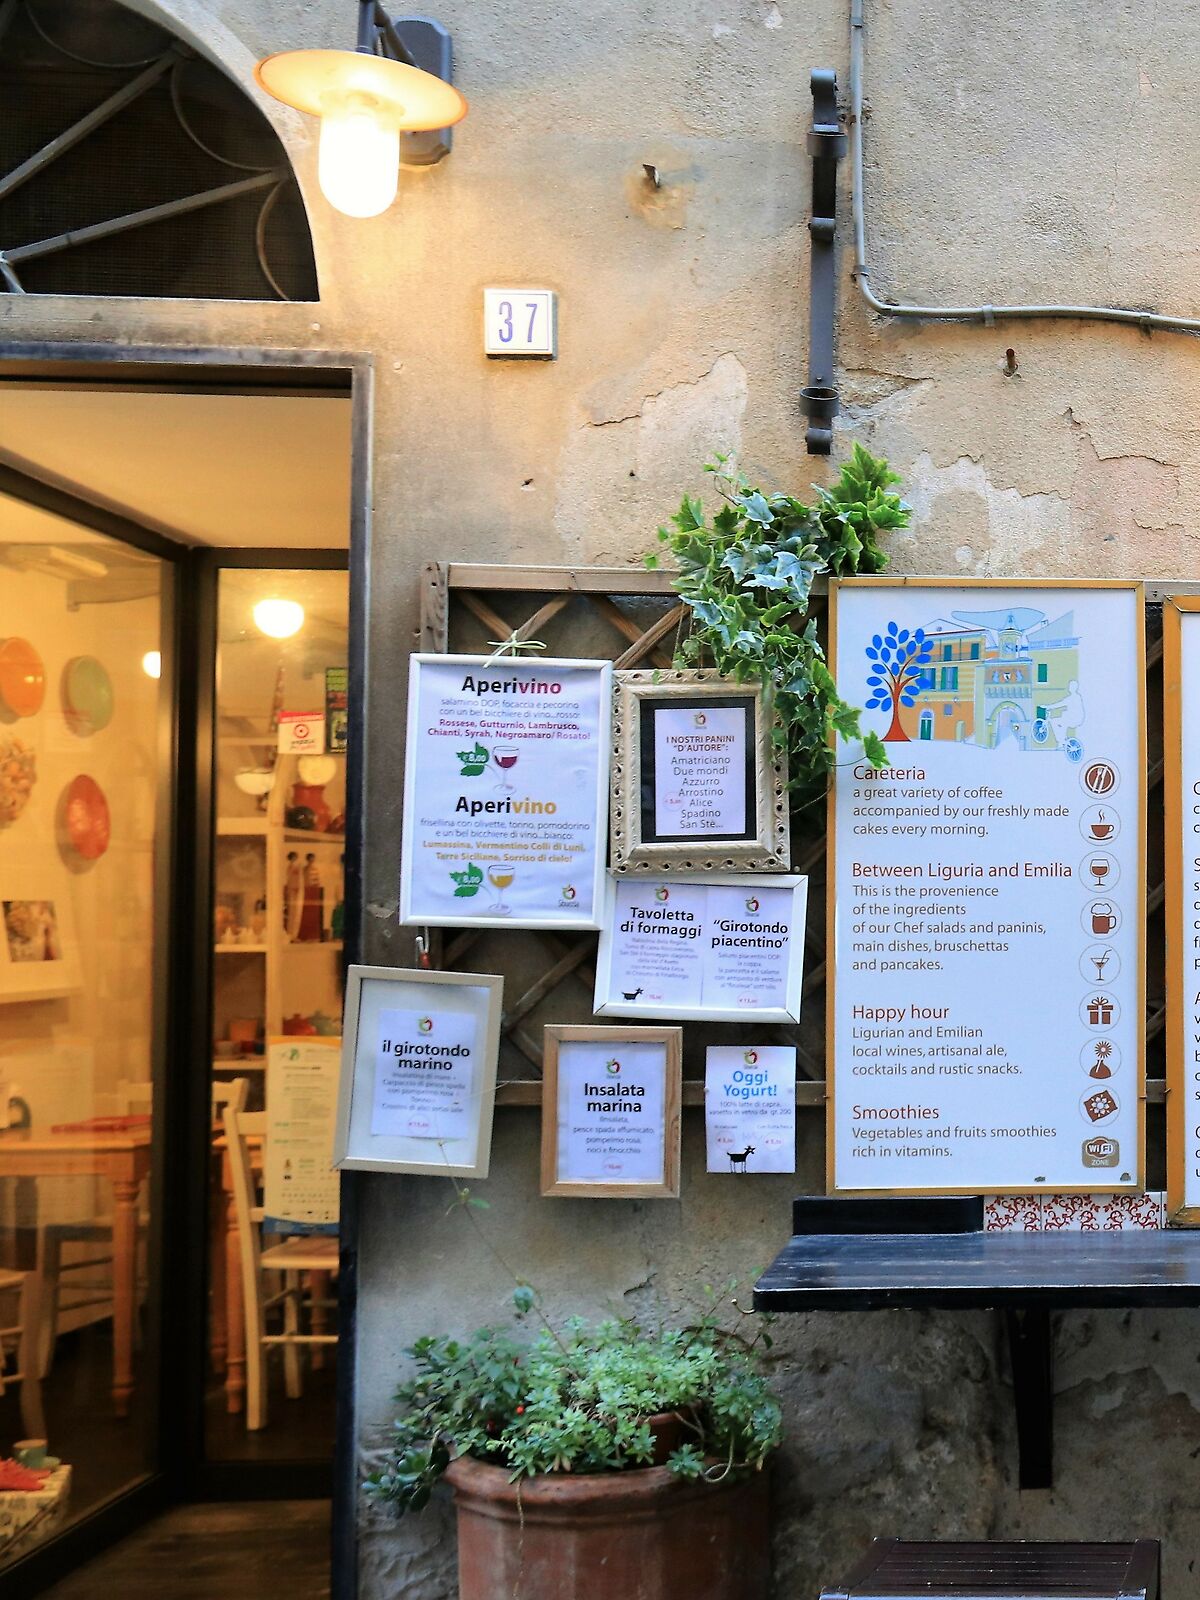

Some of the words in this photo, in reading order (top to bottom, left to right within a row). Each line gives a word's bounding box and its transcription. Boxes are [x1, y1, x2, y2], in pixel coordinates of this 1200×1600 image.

[498, 301, 538, 343] 37
[461, 676, 562, 696] Aperivino
[671, 736, 703, 744] NOSTRI
[705, 735, 735, 743] PANINI
[671, 756, 731, 765] Amatriciano
[673, 767, 694, 776] Due
[697, 766, 728, 775] mondi
[682, 778, 720, 786] Azzurro
[678, 788, 724, 797] Arrostino
[864, 788, 898, 802] great
[900, 786, 944, 801] variety
[963, 786, 1003, 801] coffee
[455, 796, 557, 817] Aperivino
[689, 799, 713, 807] Alice
[681, 809, 721, 819] Spadino
[853, 804, 940, 819] accompanied
[962, 807, 985, 817] our
[987, 803, 1030, 819] freshly
[1033, 805, 1069, 817] made
[853, 822, 888, 835] cakes
[891, 825, 927, 837] every
[930, 823, 989, 838] morning.
[853, 862, 923, 877] Between
[929, 863, 983, 881] Liguria
[988, 862, 1019, 877] and
[1024, 862, 1072, 877] Emilia
[853, 884, 879, 897] This
[894, 884, 917, 897] the
[920, 885, 1000, 900] provenience
[630, 907, 695, 922] Tavoletta
[868, 903, 890, 915] the
[891, 903, 966, 918] ingredients
[620, 921, 634, 933] di
[637, 922, 702, 939] formaggi
[868, 924, 891, 933] our
[894, 921, 925, 934] Chef
[927, 921, 967, 934] salads
[969, 921, 995, 934] and
[997, 921, 1047, 937] paninis,
[853, 940, 884, 952] main
[888, 939, 932, 953] dishes,
[934, 939, 1009, 952] bruschettas
[852, 958, 877, 970] and
[880, 958, 943, 973] pancakes.
[853, 1005, 906, 1023] Happy
[911, 1004, 949, 1019] hour
[853, 1026, 905, 1041] Ligurian
[908, 1026, 932, 1038] and
[936, 1026, 983, 1038] Emilian
[382, 1040, 391, 1053] il
[394, 1041, 471, 1057] girotondo
[853, 1044, 882, 1057] local
[885, 1044, 926, 1058] wines,
[927, 1044, 983, 1057] artisanal
[986, 1044, 1008, 1058] ale,
[398, 1058, 453, 1071] marino
[852, 1062, 907, 1076] cocktails
[911, 1062, 935, 1076] and
[939, 1063, 975, 1076] rustic
[977, 1062, 1022, 1074] snacks.
[732, 1070, 769, 1085] Oggi
[584, 1082, 645, 1097] Insalata
[723, 1084, 778, 1100] Yogurt!
[587, 1099, 642, 1112] marina
[853, 1104, 939, 1120] Smoothies
[852, 1126, 923, 1142] Vegetables
[926, 1126, 951, 1138] and
[954, 1125, 987, 1138] fruits
[990, 1125, 1057, 1137] smoothies
[853, 1145, 876, 1157] rich
[895, 1145, 952, 1157] vitamins.
